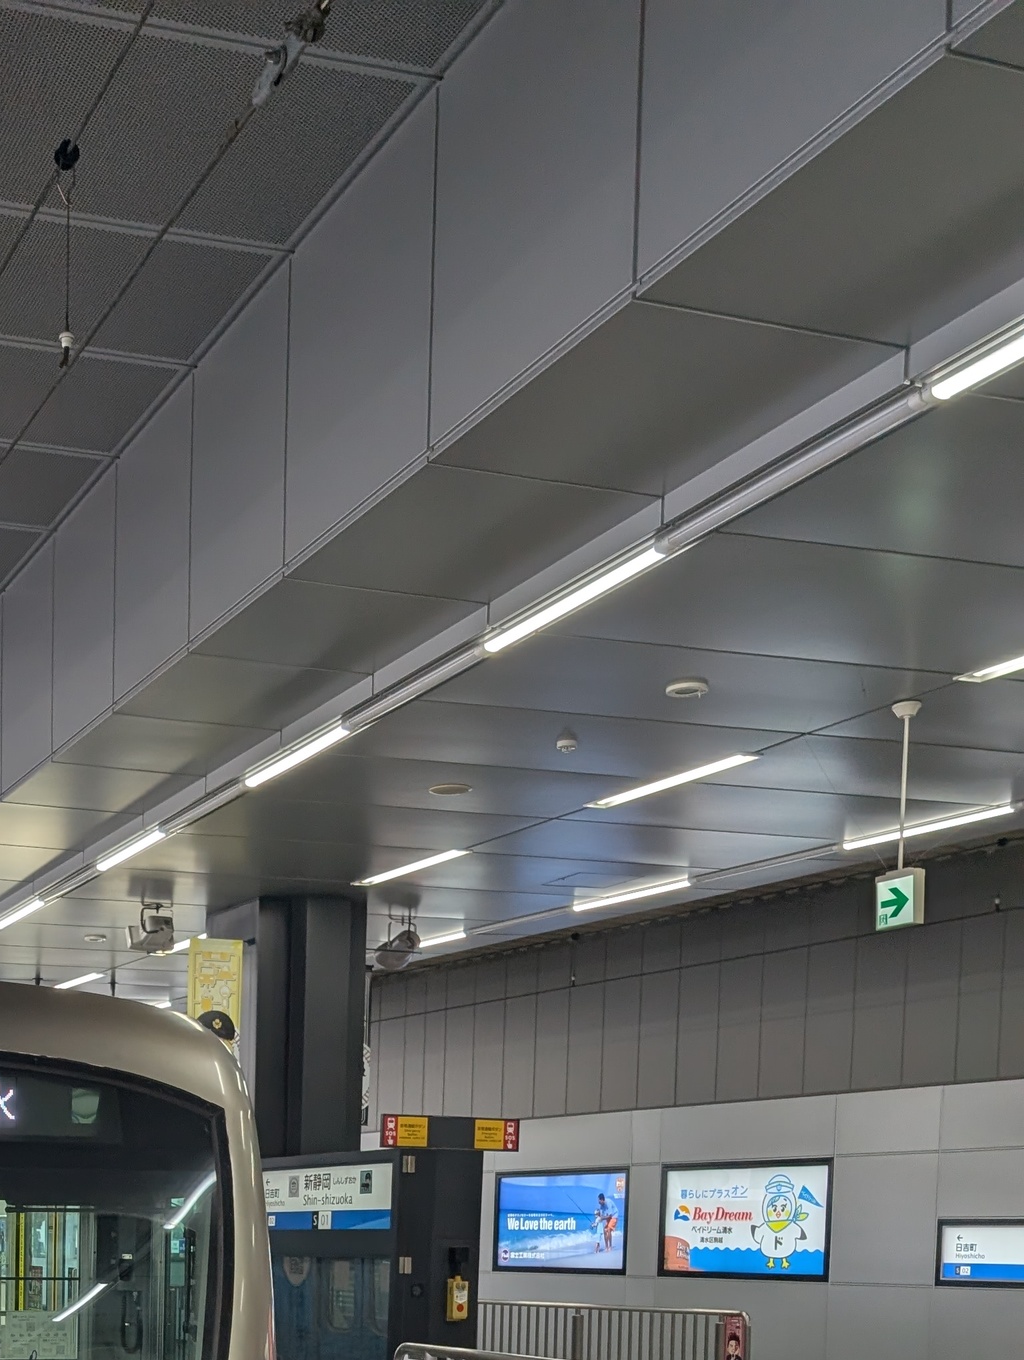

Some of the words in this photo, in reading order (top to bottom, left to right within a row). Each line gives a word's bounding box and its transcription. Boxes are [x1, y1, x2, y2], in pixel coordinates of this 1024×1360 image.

[304, 1173, 331, 1191] 新静岡
[265, 1188, 280, 1198] 日吉町
[303, 1193, 353, 1206] Shin-shizuoka
[692, 1206, 714, 1224] Bay
[714, 1206, 753, 1222] Dream
[507, 1217, 519, 1230] We
[520, 1217, 538, 1230] Love
[539, 1217, 553, 1230] the
[553, 1216, 576, 1230] earth
[956, 1243, 977, 1252] 日吉町
